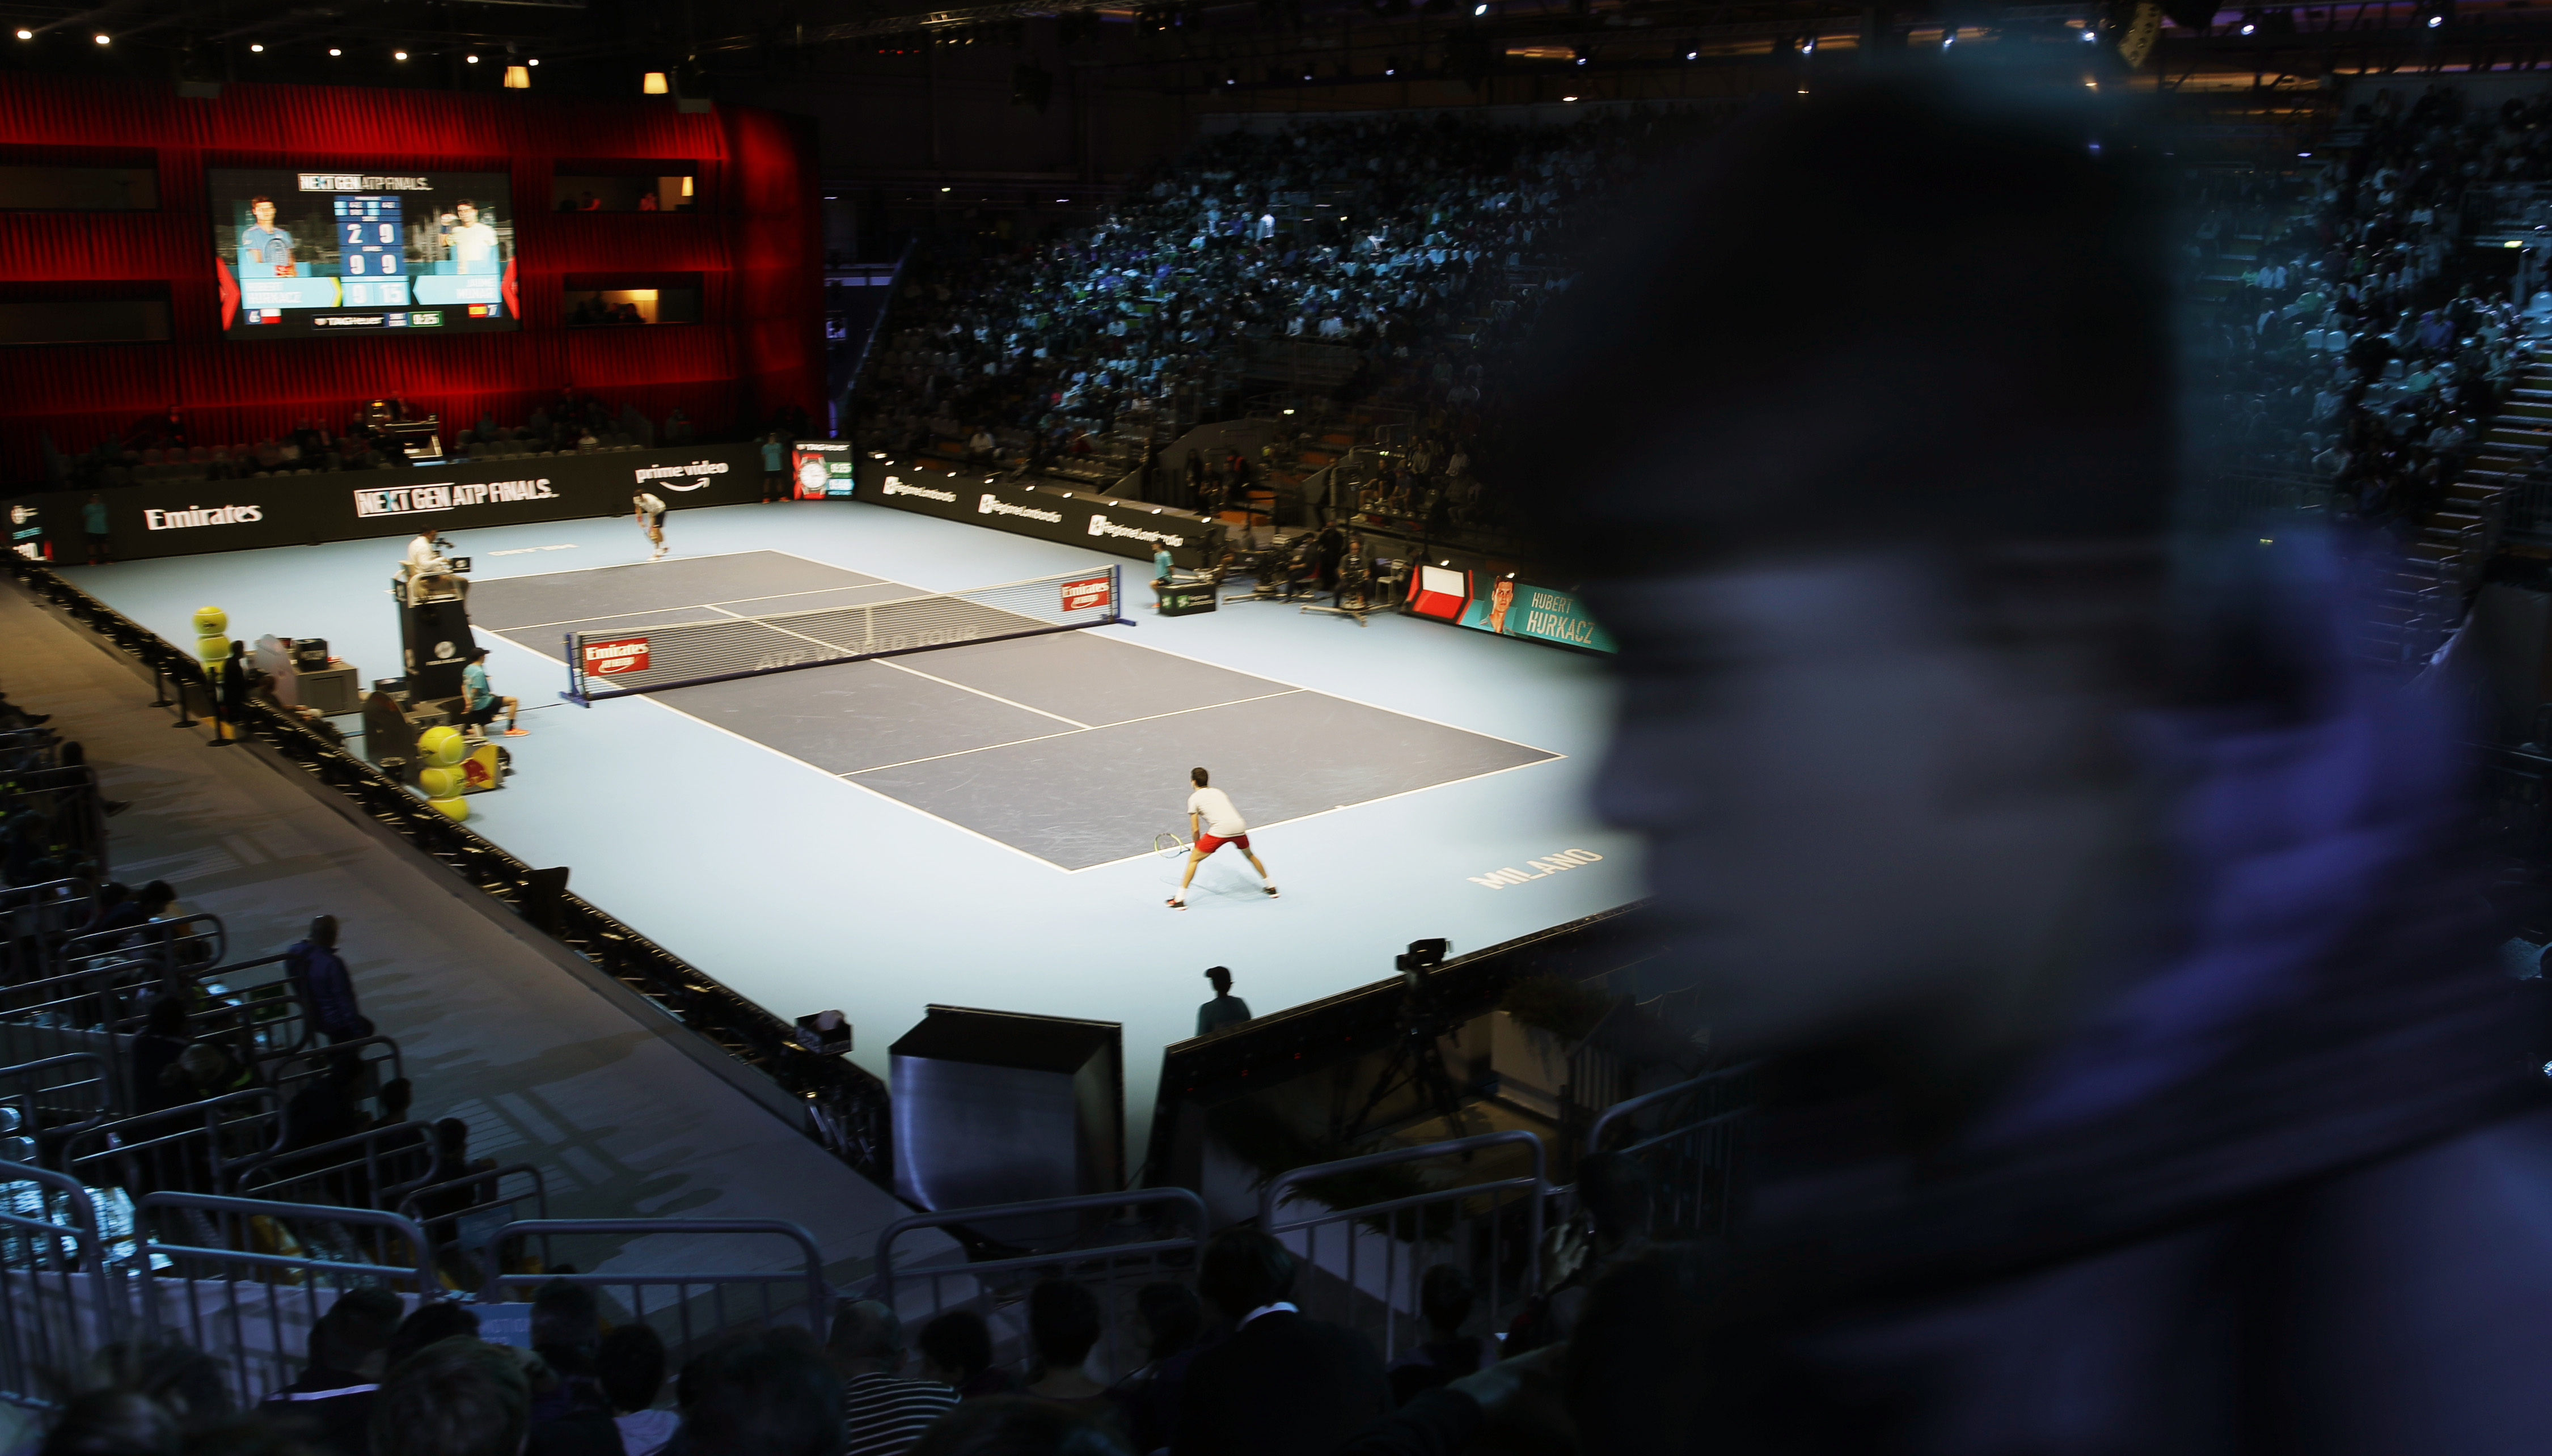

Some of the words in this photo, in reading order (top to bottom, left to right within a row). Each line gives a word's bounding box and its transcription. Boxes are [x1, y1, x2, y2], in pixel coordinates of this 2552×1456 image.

[299, 176, 335, 190] NEXT
[335, 176, 362, 190] GEN
[362, 176, 385, 190] ATP
[347, 224, 364, 243] 2
[379, 283, 404, 303] 15
[635, 464, 685, 483] prime
[683, 460, 729, 476] video
[358, 489, 411, 514] NEXT
[411, 486, 453, 510] GEN
[453, 484, 489, 506] ATP
[144, 505, 263, 530] Emirates
[1062, 582, 1110, 598] Emirates
[1531, 592, 1573, 613] HUBERT
[1526, 611, 1595, 644] HURKACZ
[585, 643, 649, 661] Emirates
[754, 650, 805, 671] ATP
[918, 624, 980, 647] TOUR
[1465, 848, 1603, 890] MILANO
